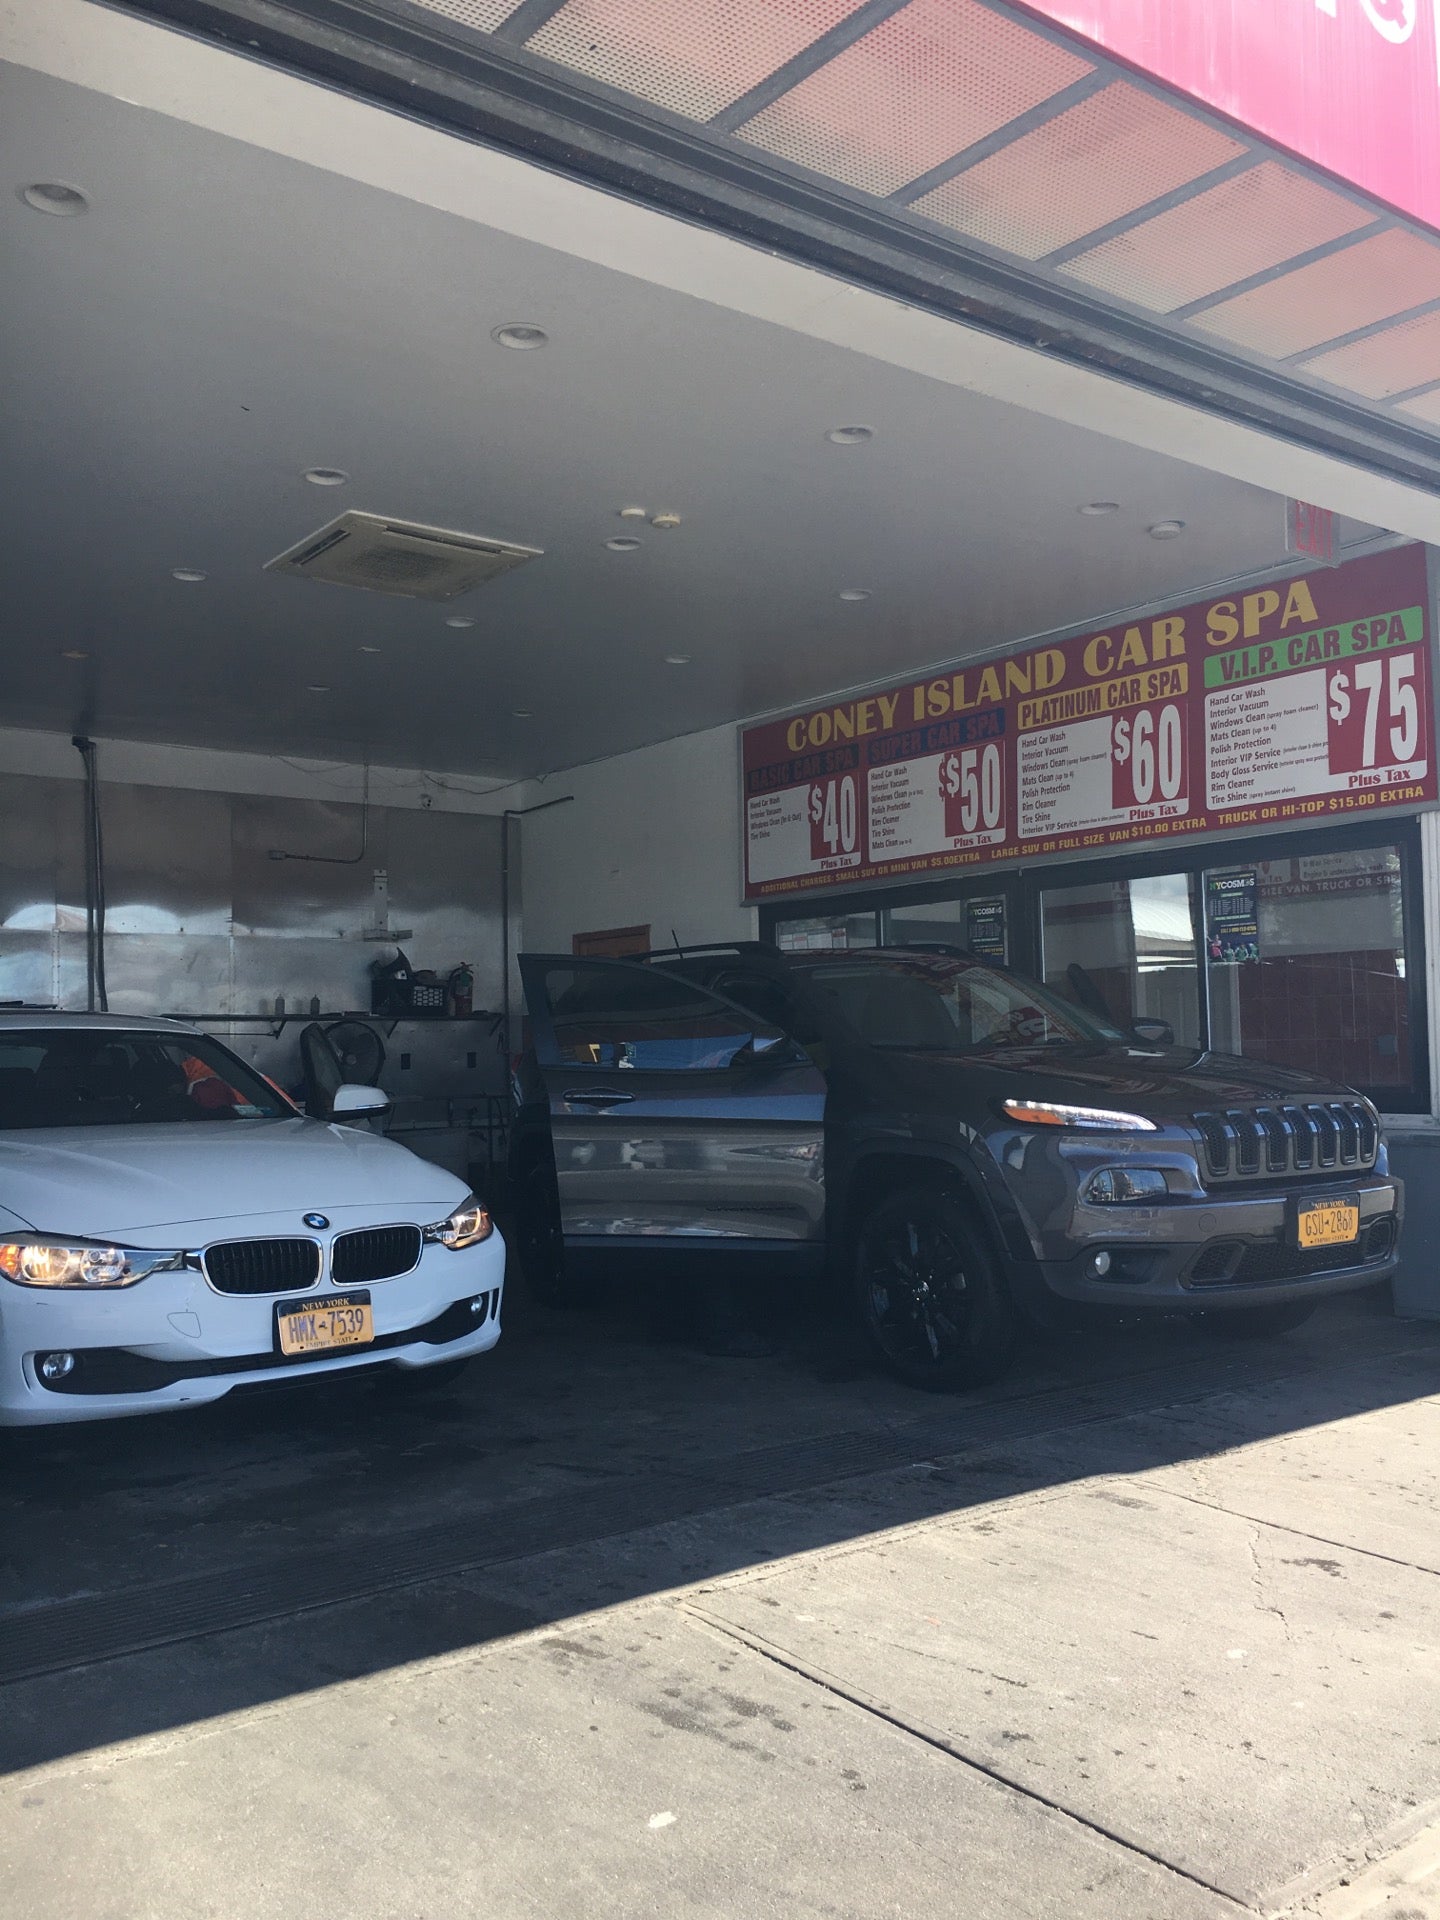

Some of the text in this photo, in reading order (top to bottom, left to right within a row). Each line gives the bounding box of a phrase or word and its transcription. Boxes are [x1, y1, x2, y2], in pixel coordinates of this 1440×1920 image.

[1295, 500, 1333, 560] EXIT
[1219, 615, 1407, 681] V.I.P. CAR SPA
[787, 580, 1318, 752] CONEY ISLAND CAR SPA
[1022, 669, 1182, 727] PLATINUM CAR SPA
[1210, 688, 1266, 707] Hand Car Wash
[1210, 700, 1269, 719] Interior Vacuum
[1329, 652, 1418, 768] $75
[1210, 718, 1244, 730] Windows
[1245, 712, 1266, 723] Clean
[870, 712, 1000, 761] SUPER CAR SPA
[1021, 731, 1066, 748] Hand Car Wash
[1210, 732, 1229, 742] Mats
[1231, 728, 1251, 738] Clean
[1252, 728, 1262, 736] (up
[1022, 745, 1068, 761] Interior Vacuum
[1114, 704, 1182, 804] $60
[1210, 743, 1231, 755] Polish
[1233, 737, 1272, 750] Protection
[1022, 762, 1049, 773] Windows
[1050, 758, 1066, 768] Clean
[1210, 755, 1238, 768] Interior
[1240, 752, 1253, 763] VIP
[1255, 748, 1281, 760] Service
[750, 748, 853, 792] BASIC CAR SPA
[871, 766, 908, 780] Hand Car Wash
[1210, 769, 1230, 780] Body
[1232, 765, 1250, 776] Gloss
[1252, 760, 1279, 772] Service
[1348, 768, 1411, 789] Plus Tax
[871, 779, 910, 792] Interior Vacuum
[946, 743, 1001, 832] $50
[1022, 776, 1037, 786] Mats
[1038, 773, 1054, 783] Clean
[1211, 779, 1255, 792] Rim Cleaner
[871, 794, 893, 803] Windows
[894, 790, 907, 799] Clean
[1022, 783, 1070, 799] Polish Protection
[1211, 793, 1225, 804] Tire
[1227, 791, 1248, 802] Shine
[872, 801, 911, 815] Polish Protection
[1022, 799, 1057, 812] Rim Cleaner
[1129, 808, 1155, 821] Plus
[1158, 804, 1178, 816] Tax
[811, 775, 856, 854] $40
[872, 816, 900, 827] Rim Cleaner
[1022, 811, 1051, 824] Tire Shine
[872, 826, 895, 838] Tire Shine
[1022, 825, 1044, 835] Interior
[1045, 822, 1056, 832] VIP
[1056, 820, 1078, 831] Service
[760, 880, 799, 893] ADDITIONAL
[800, 874, 834, 888] CHARGES:
[836, 870, 860, 882] SMALL
[861, 867, 876, 878] SUV
[879, 865, 889, 875] OR
[890, 863, 909, 873] MINI
[911, 859, 928, 870] VAN
[991, 846, 1019, 859] LARGE
[1022, 843, 1040, 855] SUV
[1043, 840, 1056, 851] OR
[1059, 836, 1080, 849] FULL
[1083, 833, 1104, 846] SIZE
[1109, 829, 1130, 841] VAN
[1131, 822, 1169, 837] $10.00
[1172, 817, 1207, 831] EXTRA
[1218, 810, 1257, 825] TRUCK
[1261, 806, 1278, 819] OR
[1282, 800, 1325, 815] HI-TOP
[1329, 793, 1376, 811] $15.00
[1380, 785, 1424, 803] EXTRA
[872, 841, 884, 849] Mats
[885, 838, 898, 847] Clean
[953, 834, 992, 848] Plus Tax
[820, 856, 853, 870] Plus Tax
[1260, 886, 1283, 897] SIZE
[1316, 878, 1351, 890] TRUCK
[1356, 876, 1372, 887] OR
[302, 1298, 350, 1312] NEW YORK
